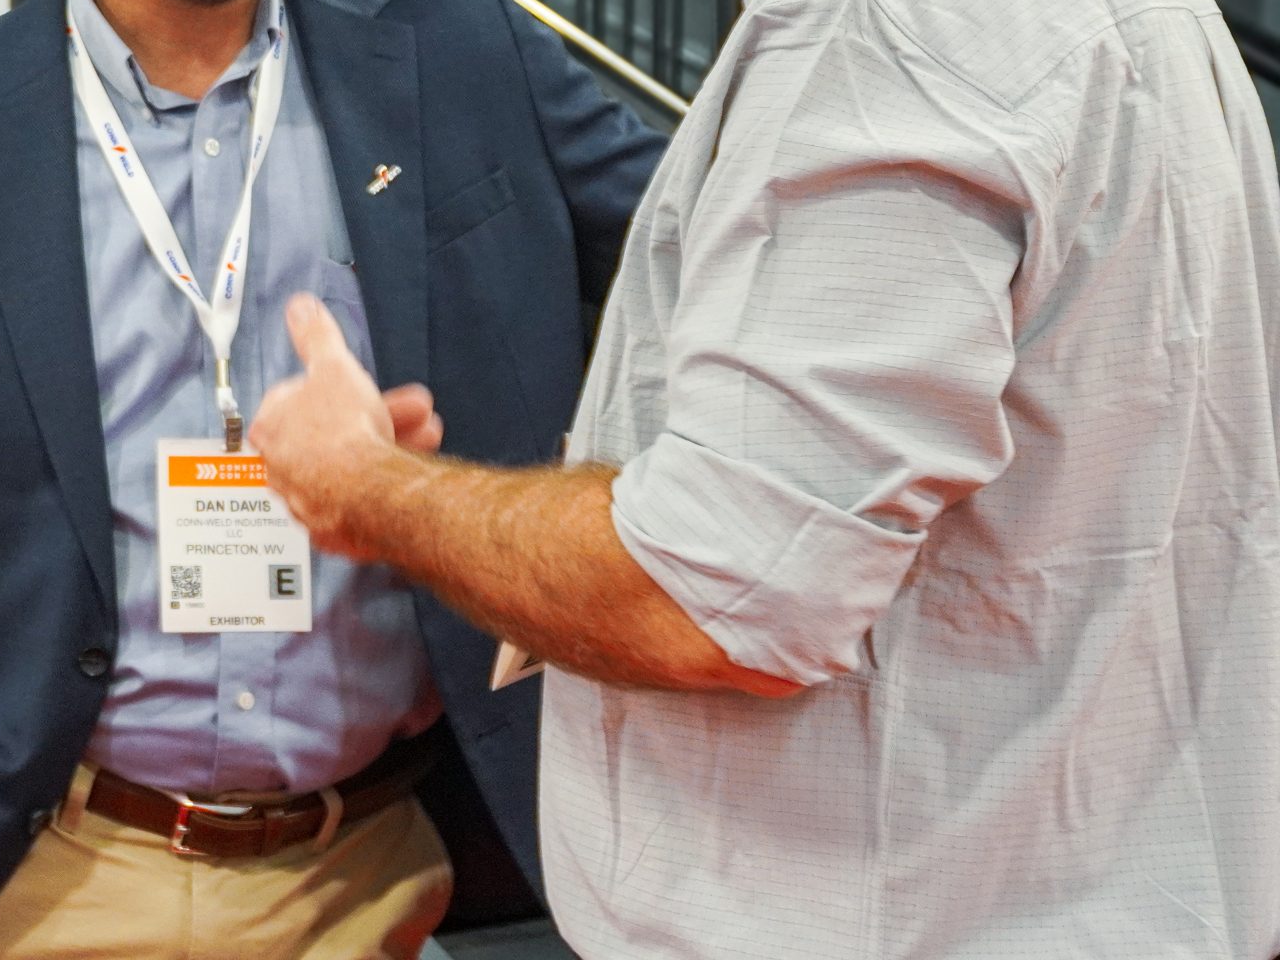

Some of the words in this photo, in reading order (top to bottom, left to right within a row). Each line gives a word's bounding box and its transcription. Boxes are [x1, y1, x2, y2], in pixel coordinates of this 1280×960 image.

[196, 500, 224, 512] DAN
[230, 500, 271, 512] DAVIS
[176, 518, 232, 527] CONN-WELD
[235, 518, 288, 527] INDUSTRIES
[227, 529, 242, 538] LLC
[265, 544, 284, 555] WV
[276, 568, 295, 595] E
[210, 617, 265, 625] EXHIBITOR
